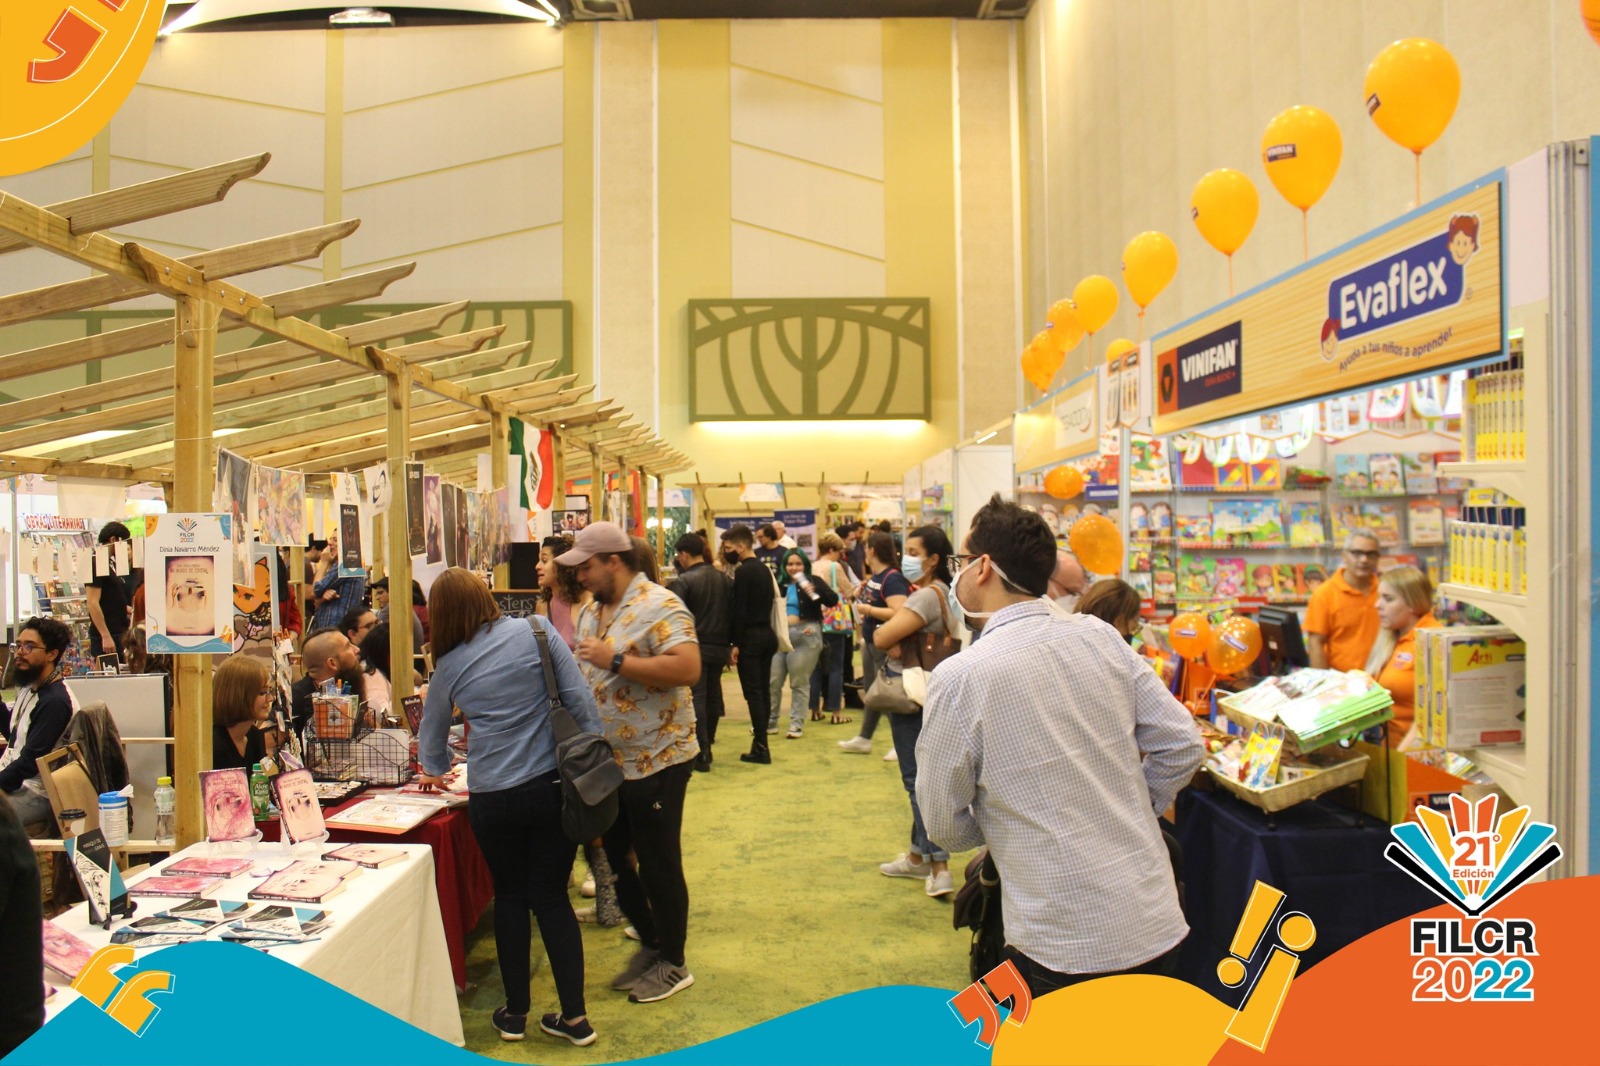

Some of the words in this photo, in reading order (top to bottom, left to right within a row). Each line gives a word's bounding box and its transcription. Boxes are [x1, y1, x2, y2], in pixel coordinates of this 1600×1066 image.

[1340, 256, 1447, 330] Evaflex
[1181, 339, 1236, 383] VINIFAN
[1340, 347, 1361, 371] Ayuda
[1368, 342, 1380, 352] tus
[1382, 341, 1403, 356] niños
[1404, 346, 1411, 357] a
[1412, 327, 1453, 359] aprender
[1466, 649, 1493, 667] Arti
